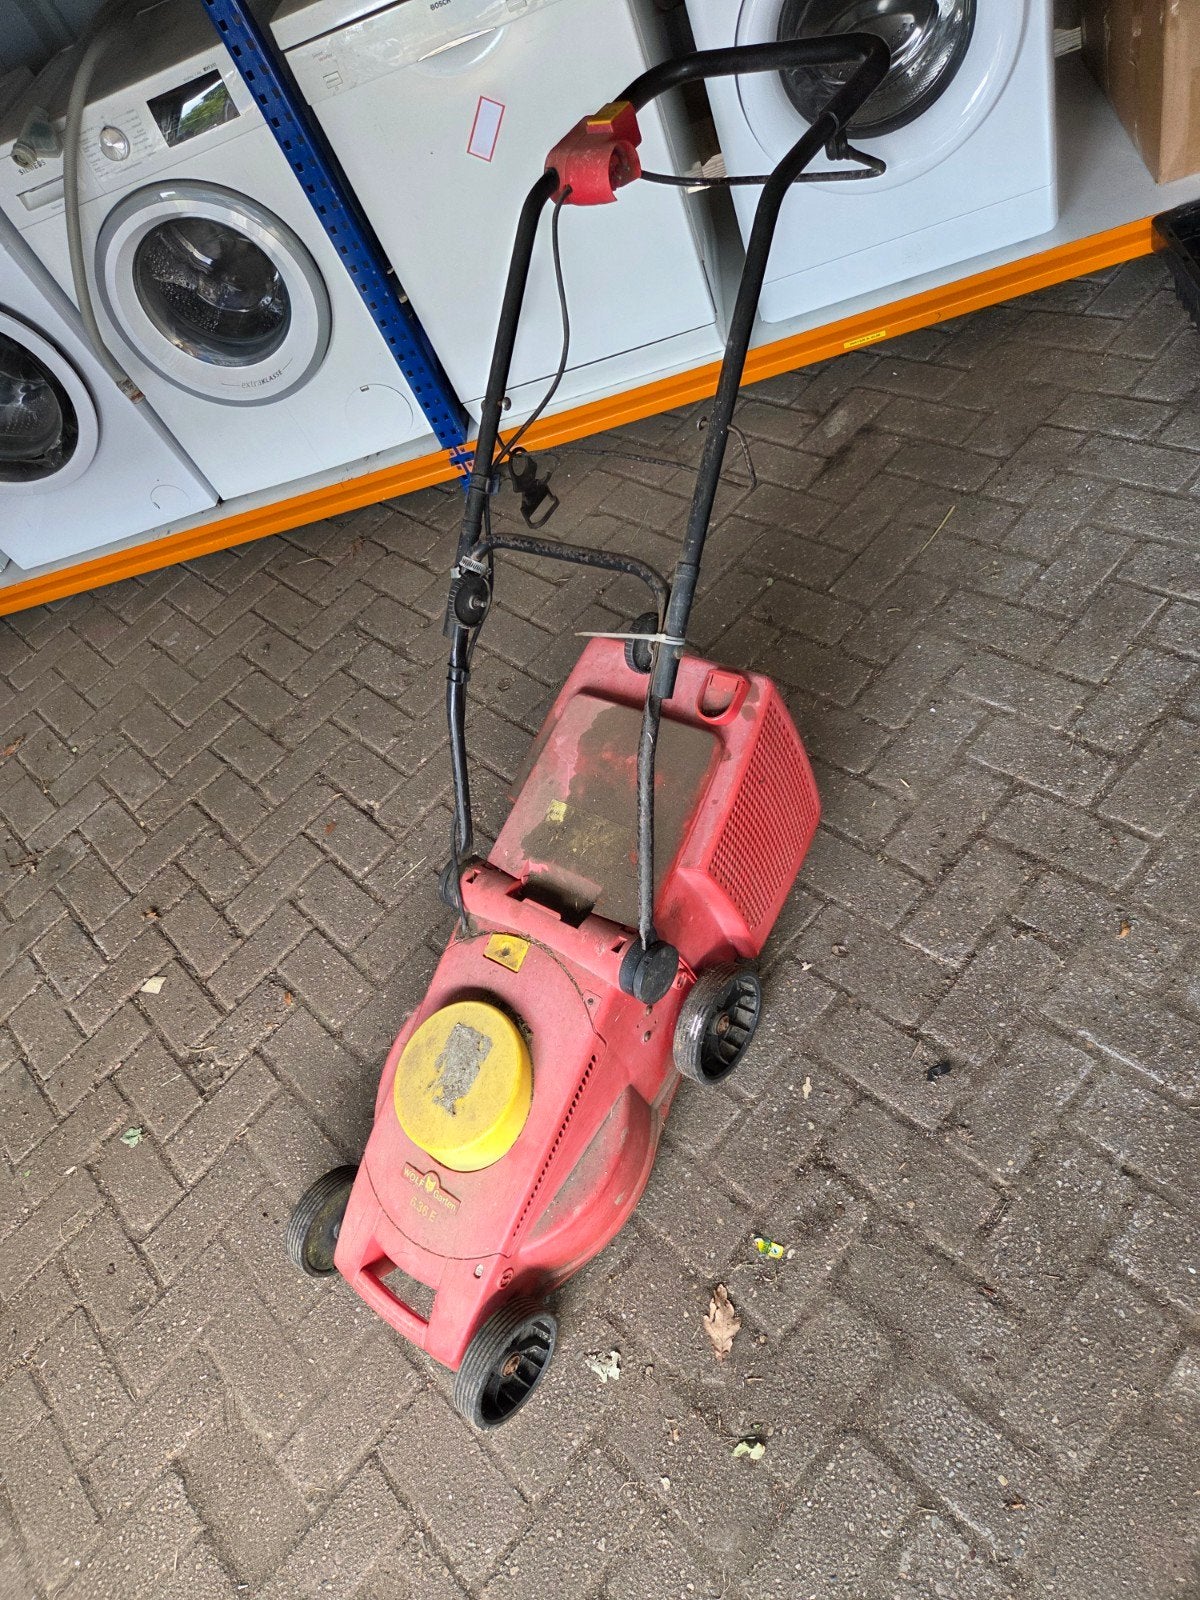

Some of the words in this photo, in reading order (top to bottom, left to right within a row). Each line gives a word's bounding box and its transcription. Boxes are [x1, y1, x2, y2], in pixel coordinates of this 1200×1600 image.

[241, 369, 283, 389] extraKLASSE
[403, 1167, 425, 1187] WOLF
[433, 1189, 456, 1211] Garten
